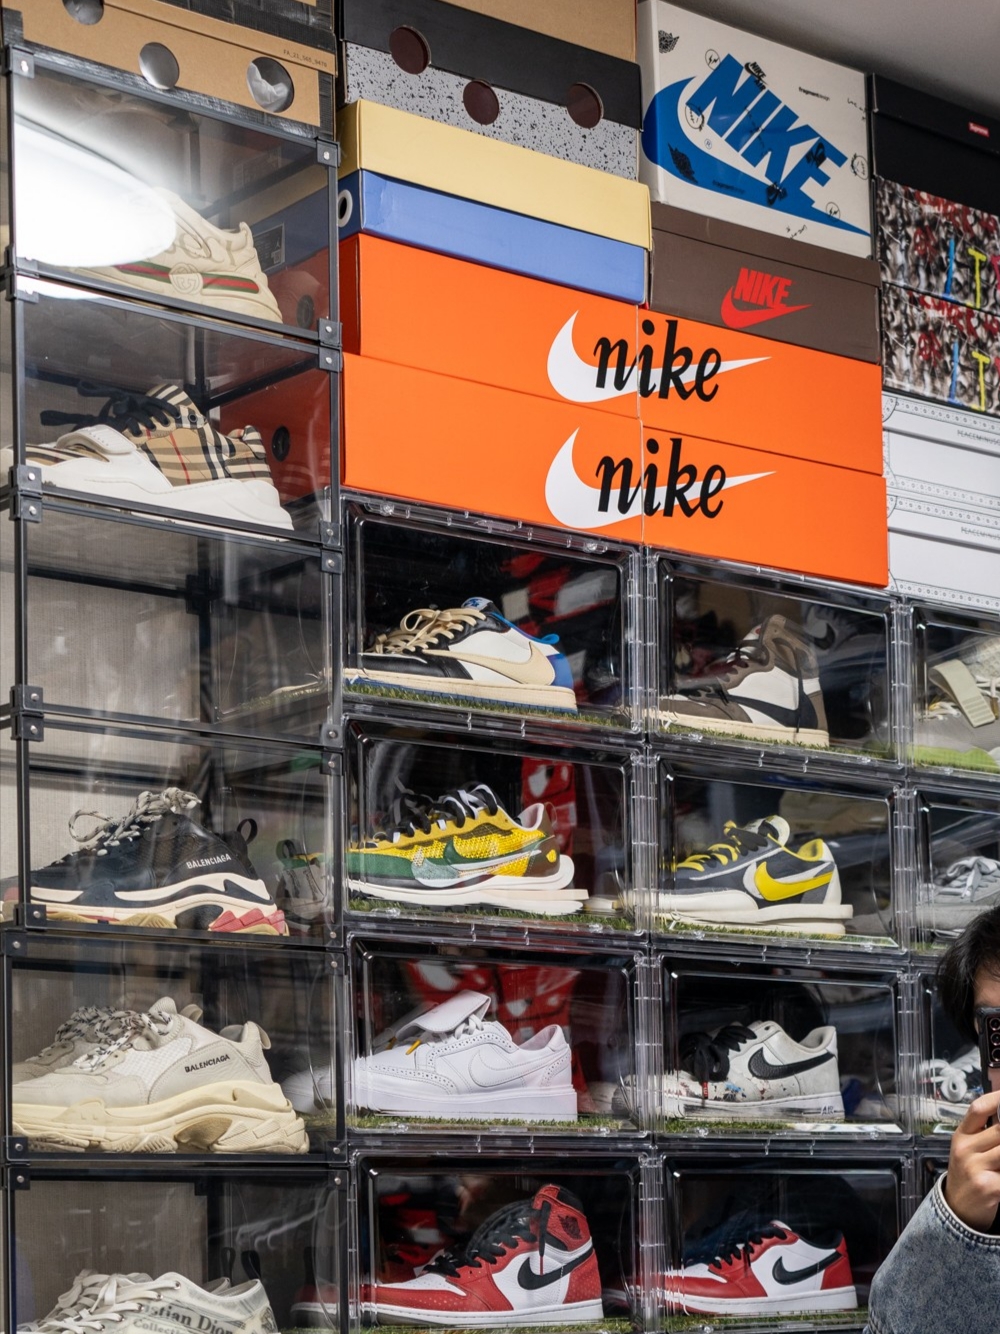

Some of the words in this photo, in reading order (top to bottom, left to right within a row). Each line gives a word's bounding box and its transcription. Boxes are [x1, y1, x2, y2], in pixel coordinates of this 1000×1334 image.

[686, 53, 848, 208] NIKE
[733, 266, 792, 310] NIKE
[593, 319, 721, 402] nike
[596, 438, 726, 518] nike
[186, 853, 232, 869] BALENCIAGA
[184, 1053, 231, 1073] BALENCIAGA
